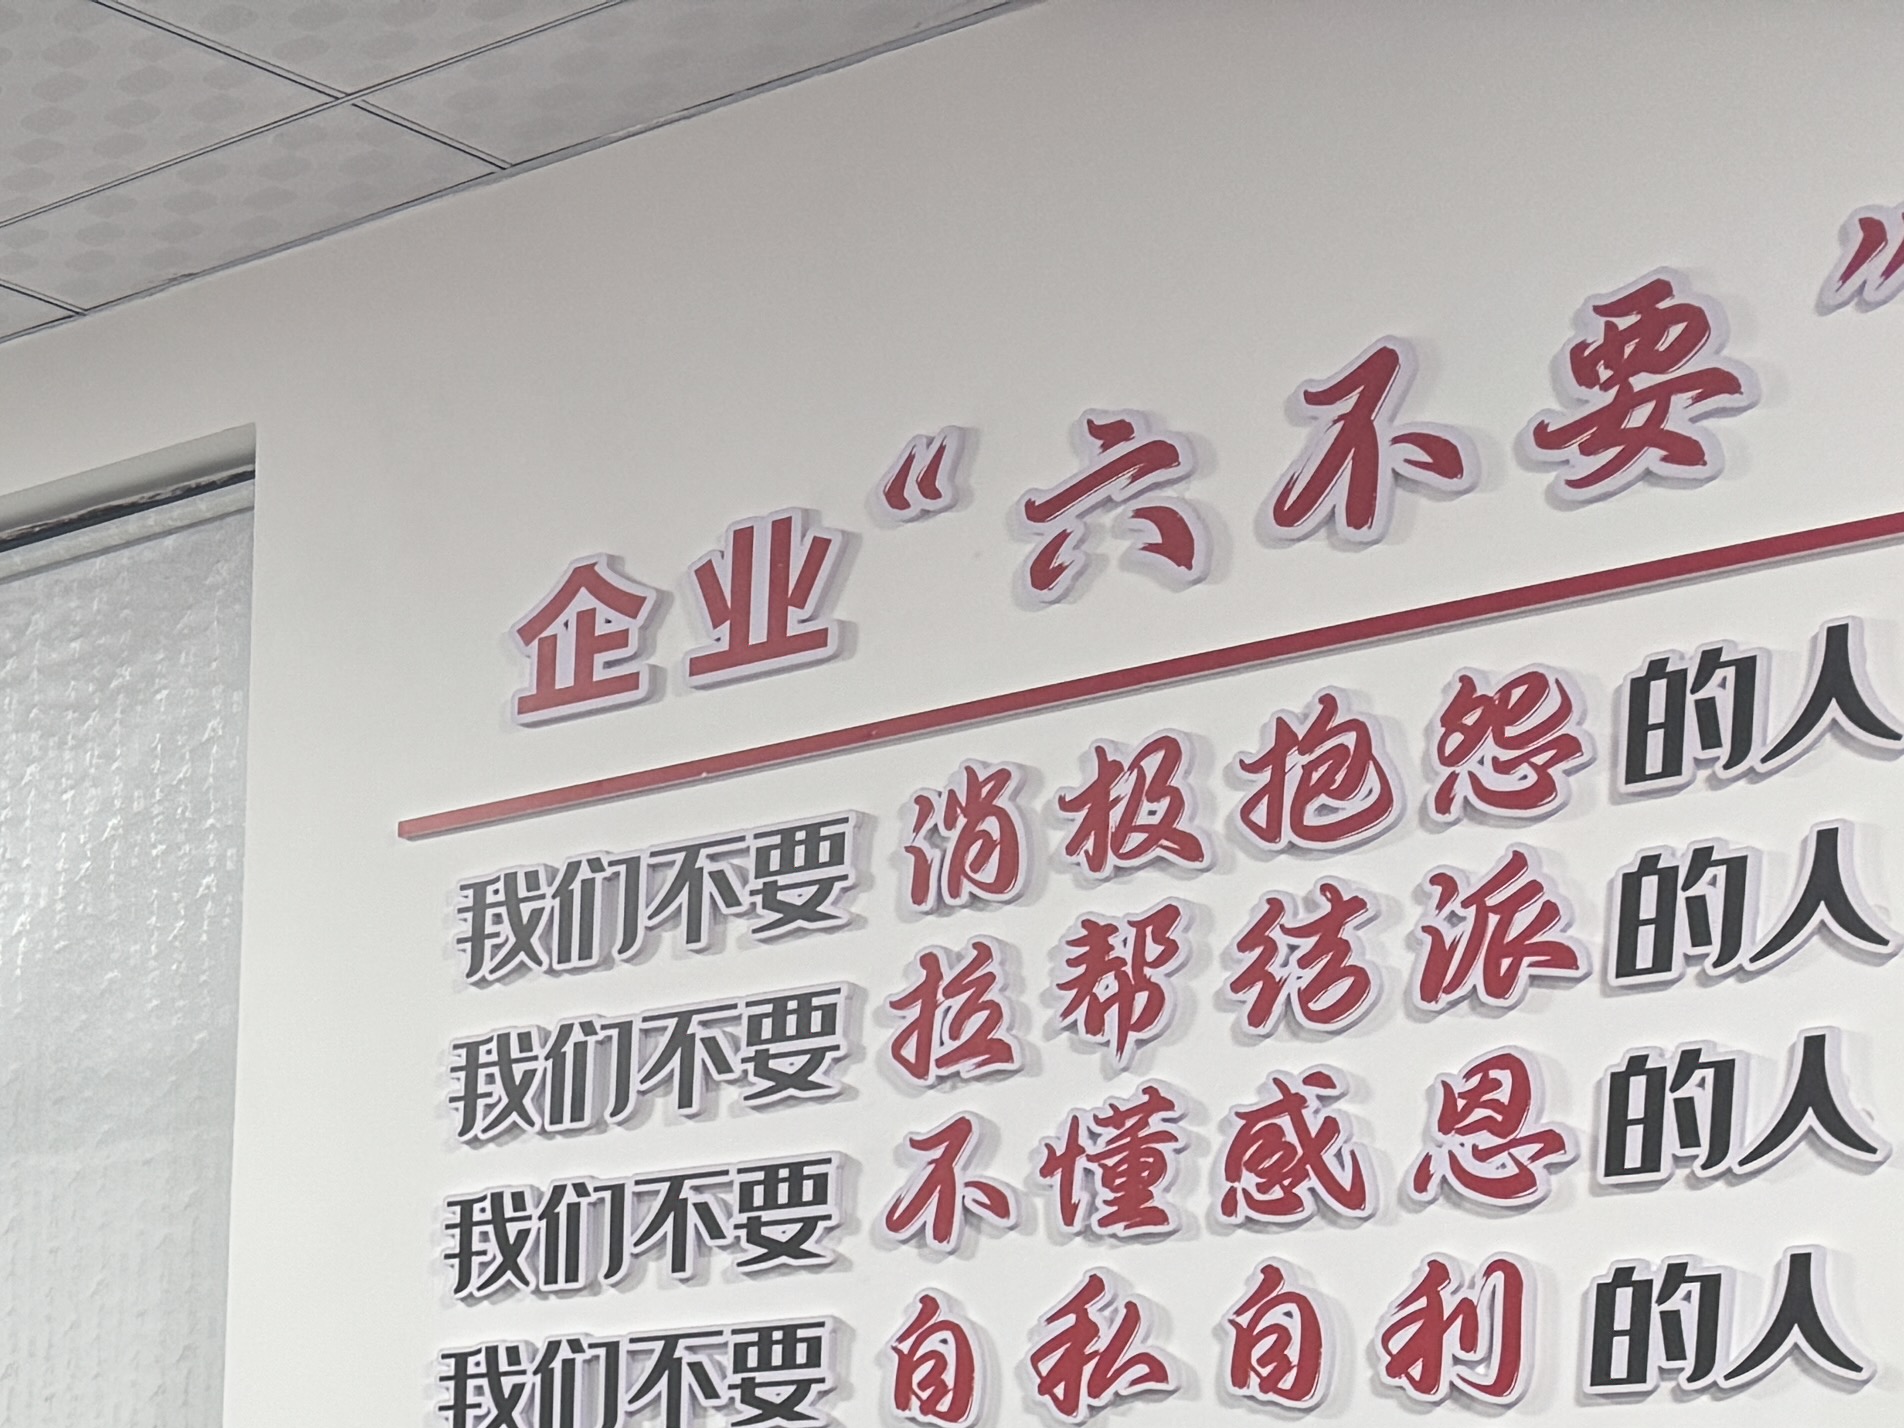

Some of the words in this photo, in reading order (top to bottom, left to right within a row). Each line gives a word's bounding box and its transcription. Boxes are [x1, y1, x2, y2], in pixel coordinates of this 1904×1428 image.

[457, 622, 1903, 979] 我们不要消极抱怨的人
[449, 827, 1890, 1138] 我们不要拉帮结派的人
[444, 1034, 1878, 1295] 我们不要不懂感恩的人
